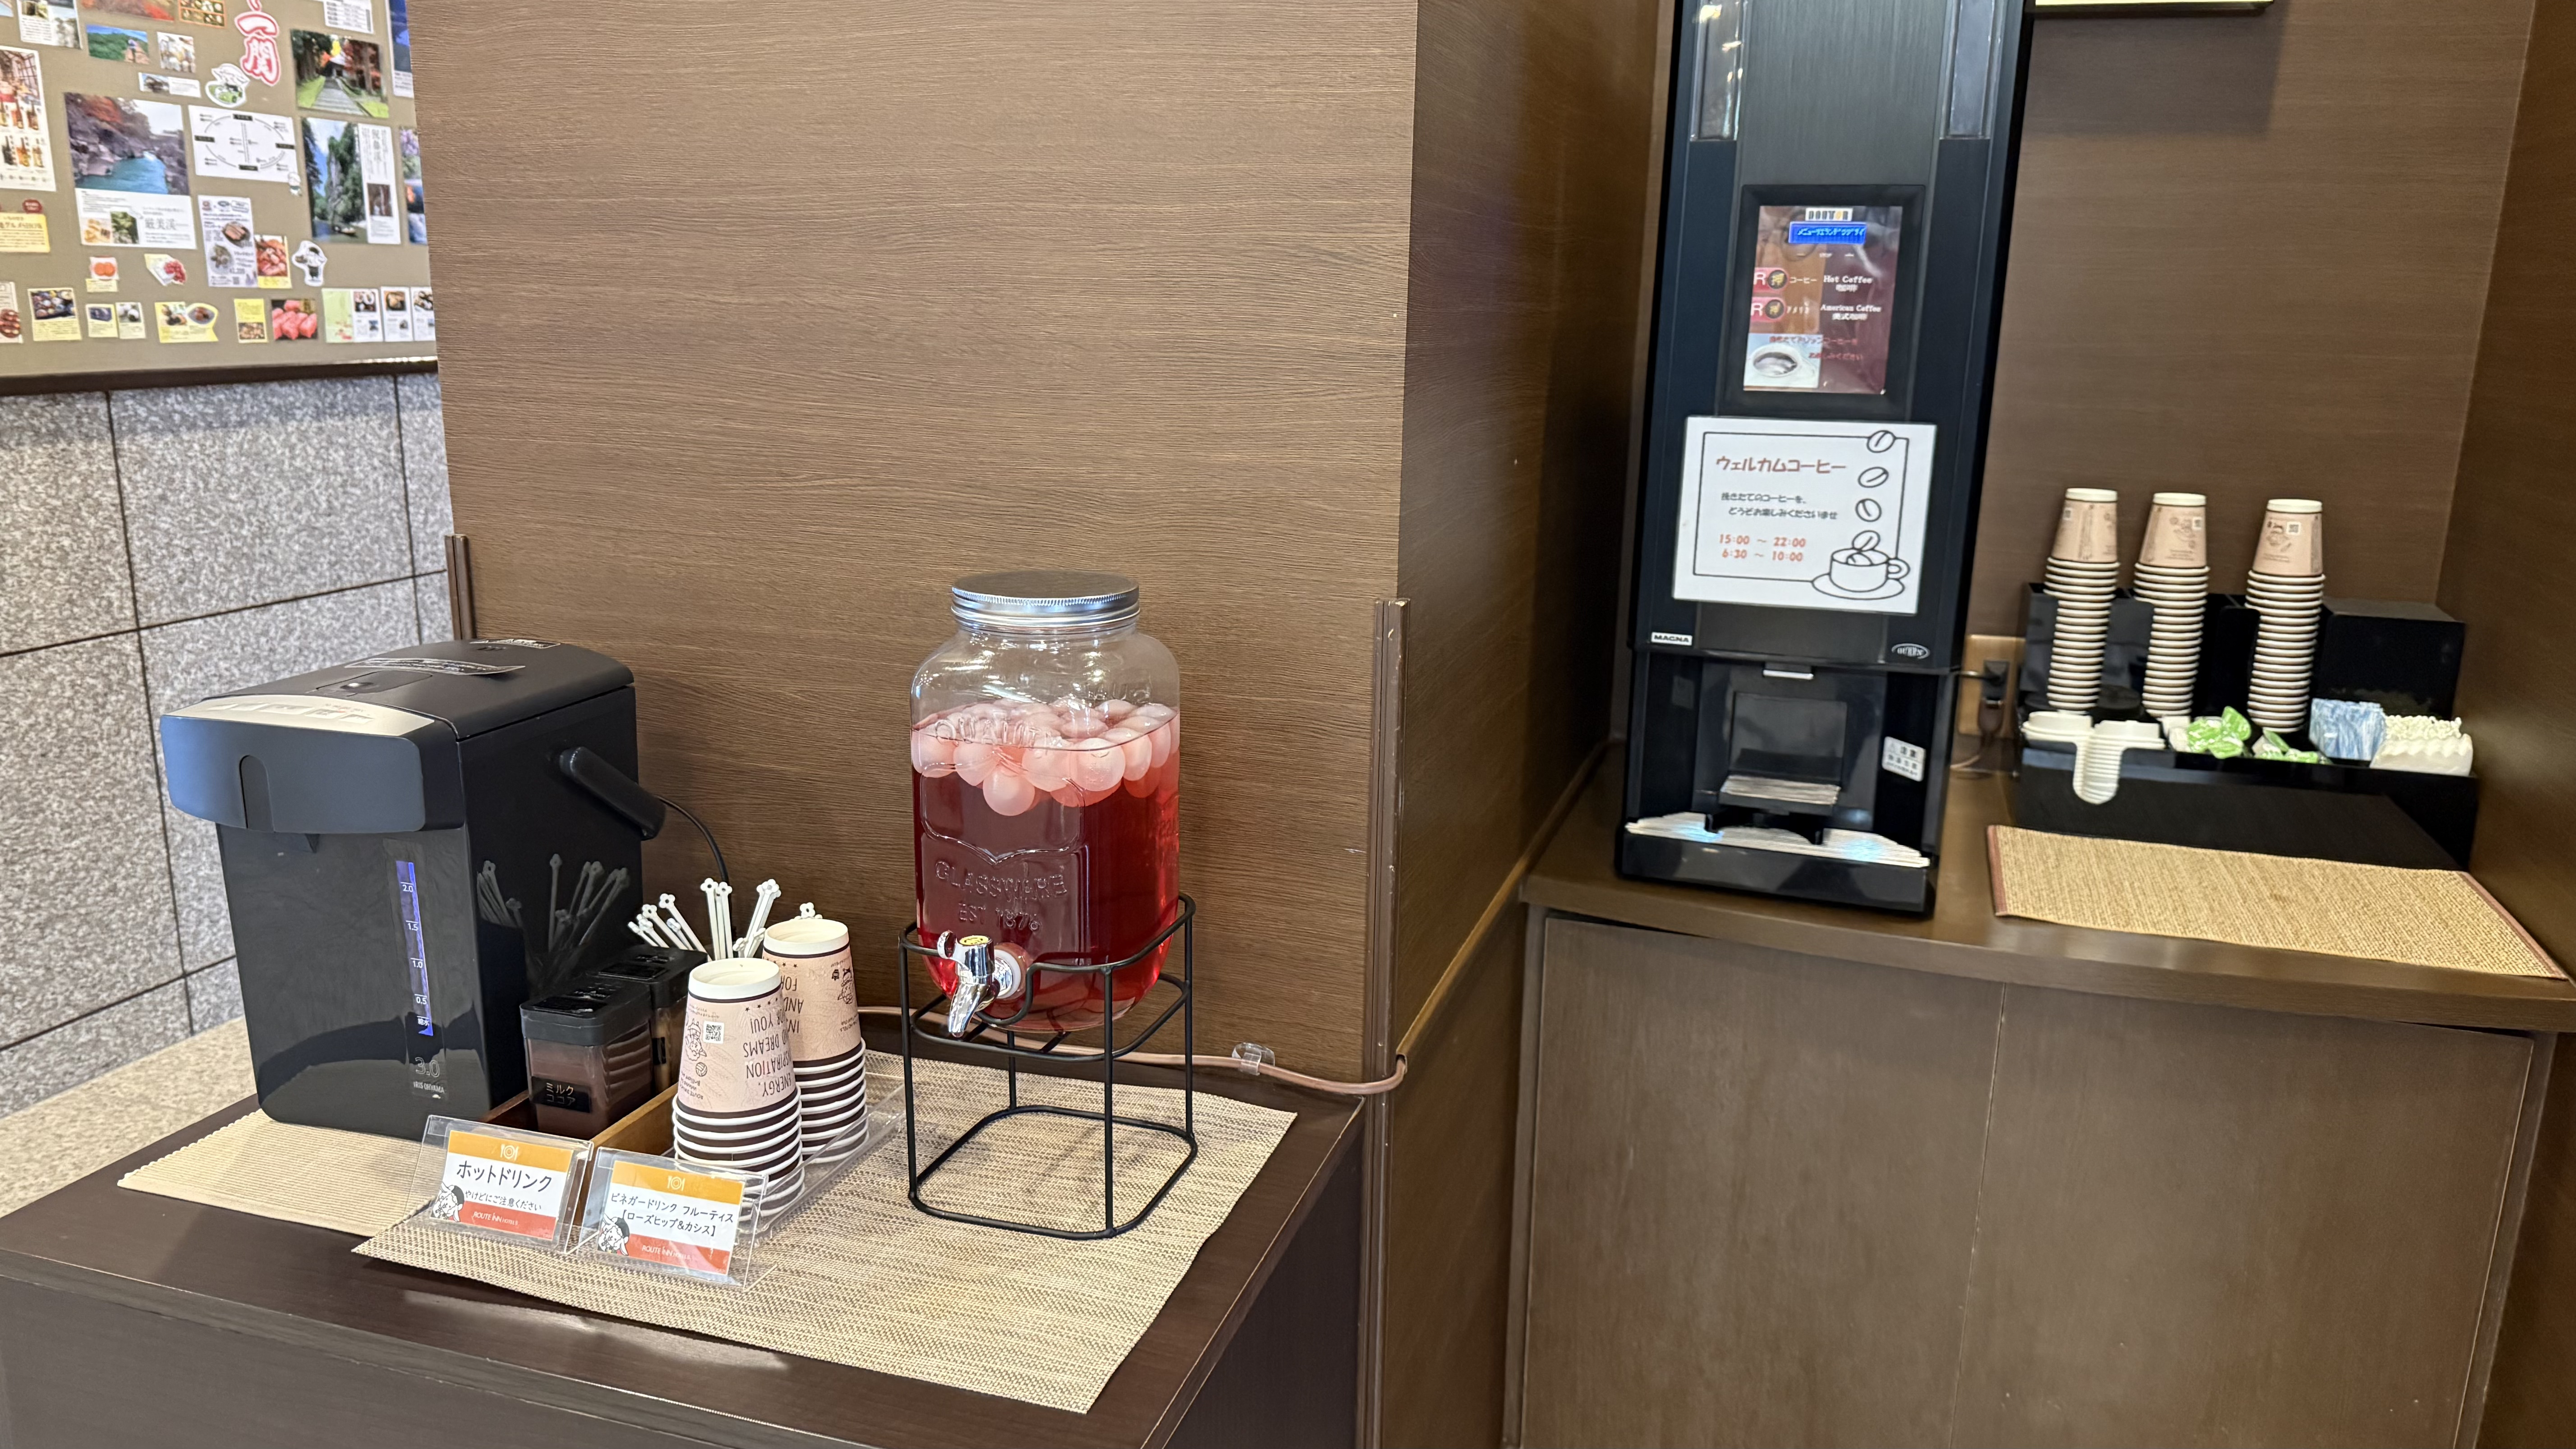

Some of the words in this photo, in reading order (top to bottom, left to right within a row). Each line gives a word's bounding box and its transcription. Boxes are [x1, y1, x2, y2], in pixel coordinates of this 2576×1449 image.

[1823, 275, 1839, 283] Hot
[1842, 276, 1872, 284] Coffee
[1716, 455, 1846, 474] ウェルカムコーヒー
[1719, 534, 1750, 545] 15:00
[1773, 537, 1806, 547] 22:00
[1721, 549, 1747, 559] 6:30
[1772, 551, 1803, 562] 10:00
[1654, 635, 1689, 643] MAGNA
[402, 884, 414, 892] 2.0
[958, 902, 987, 925] EST
[408, 922, 419, 931] 1.5
[413, 960, 423, 969] 1.0
[416, 996, 427, 1005] 0.5
[750, 1012, 774, 1034] YOU!
[743, 1034, 779, 1058] DREAMS
[415, 1057, 440, 1078] 3.0
[546, 1082, 574, 1095] ミルク
[546, 1094, 576, 1106] ココア
[456, 1160, 552, 1192] ホットドリンク
[465, 1190, 542, 1211] やけどにご注意ください
[611, 1192, 677, 1212] ビネガードリンク
[683, 1205, 733, 1223] フルーティス
[473, 1211, 491, 1221] ROUTE
[642, 1245, 661, 1254] ROUTE
